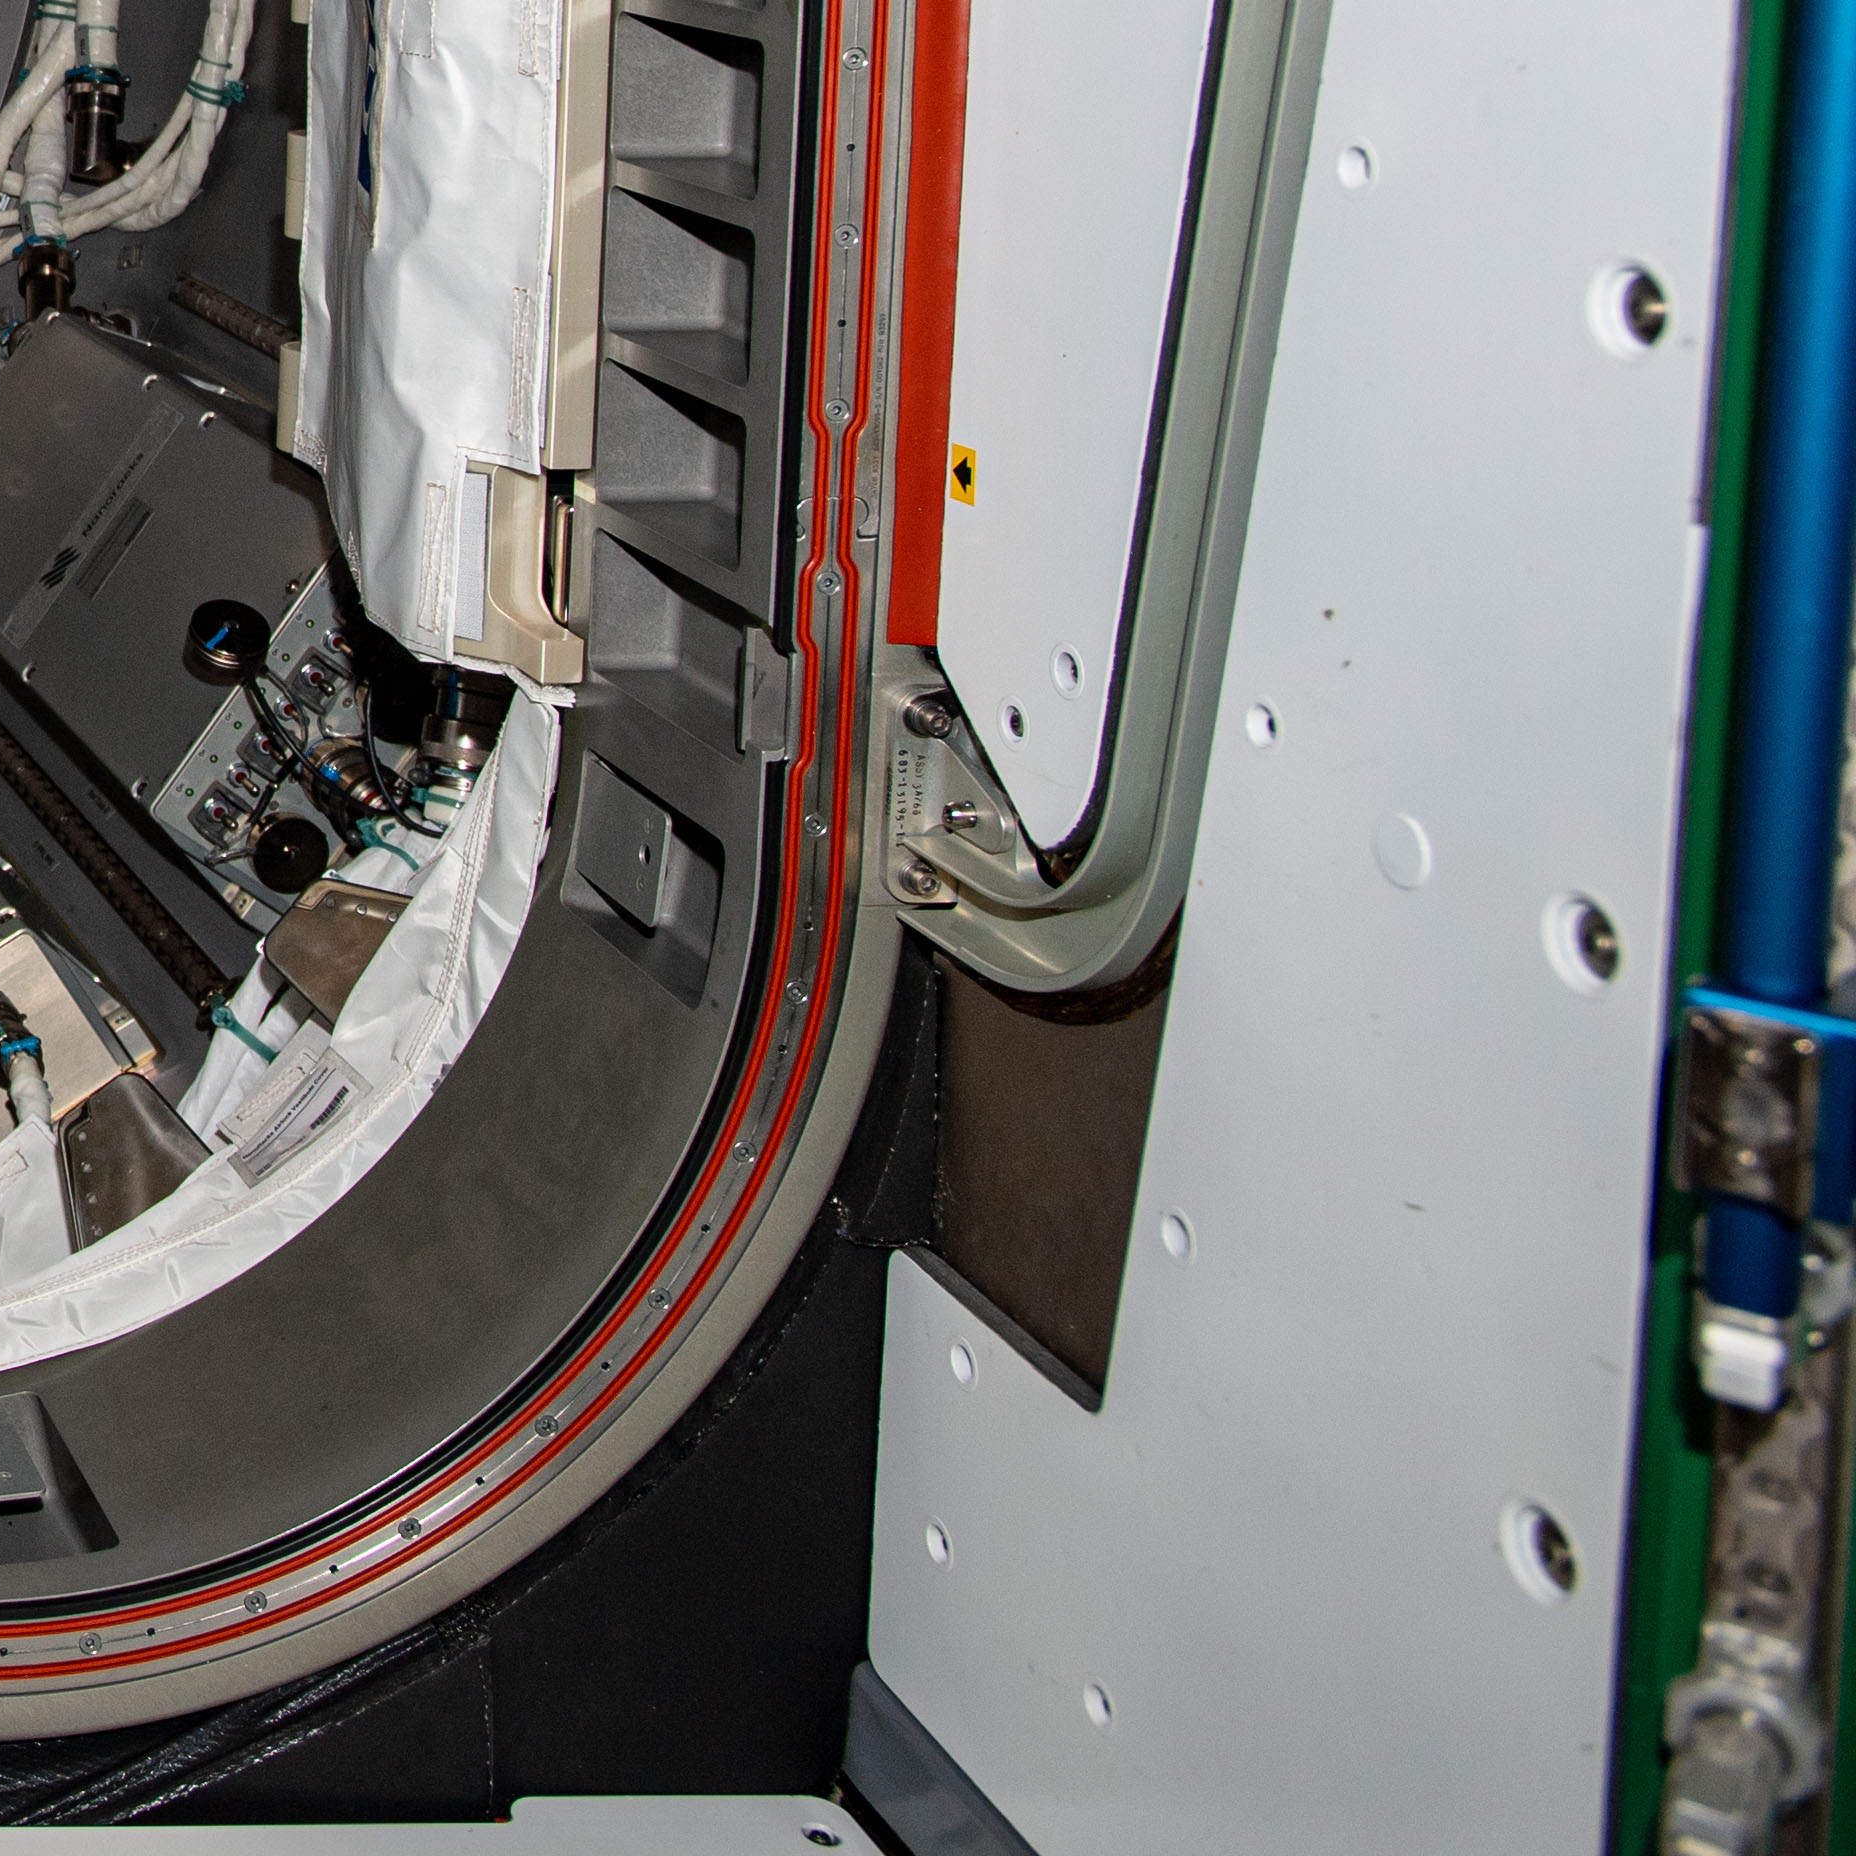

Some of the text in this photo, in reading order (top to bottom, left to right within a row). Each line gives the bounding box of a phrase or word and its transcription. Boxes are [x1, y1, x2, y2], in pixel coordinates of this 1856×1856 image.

[81, 452, 146, 537] Nanoracks
[273, 1111, 295, 1133] Airlock
[291, 1083, 316, 1113] Vestibule
[313, 1066, 330, 1086] Cover
